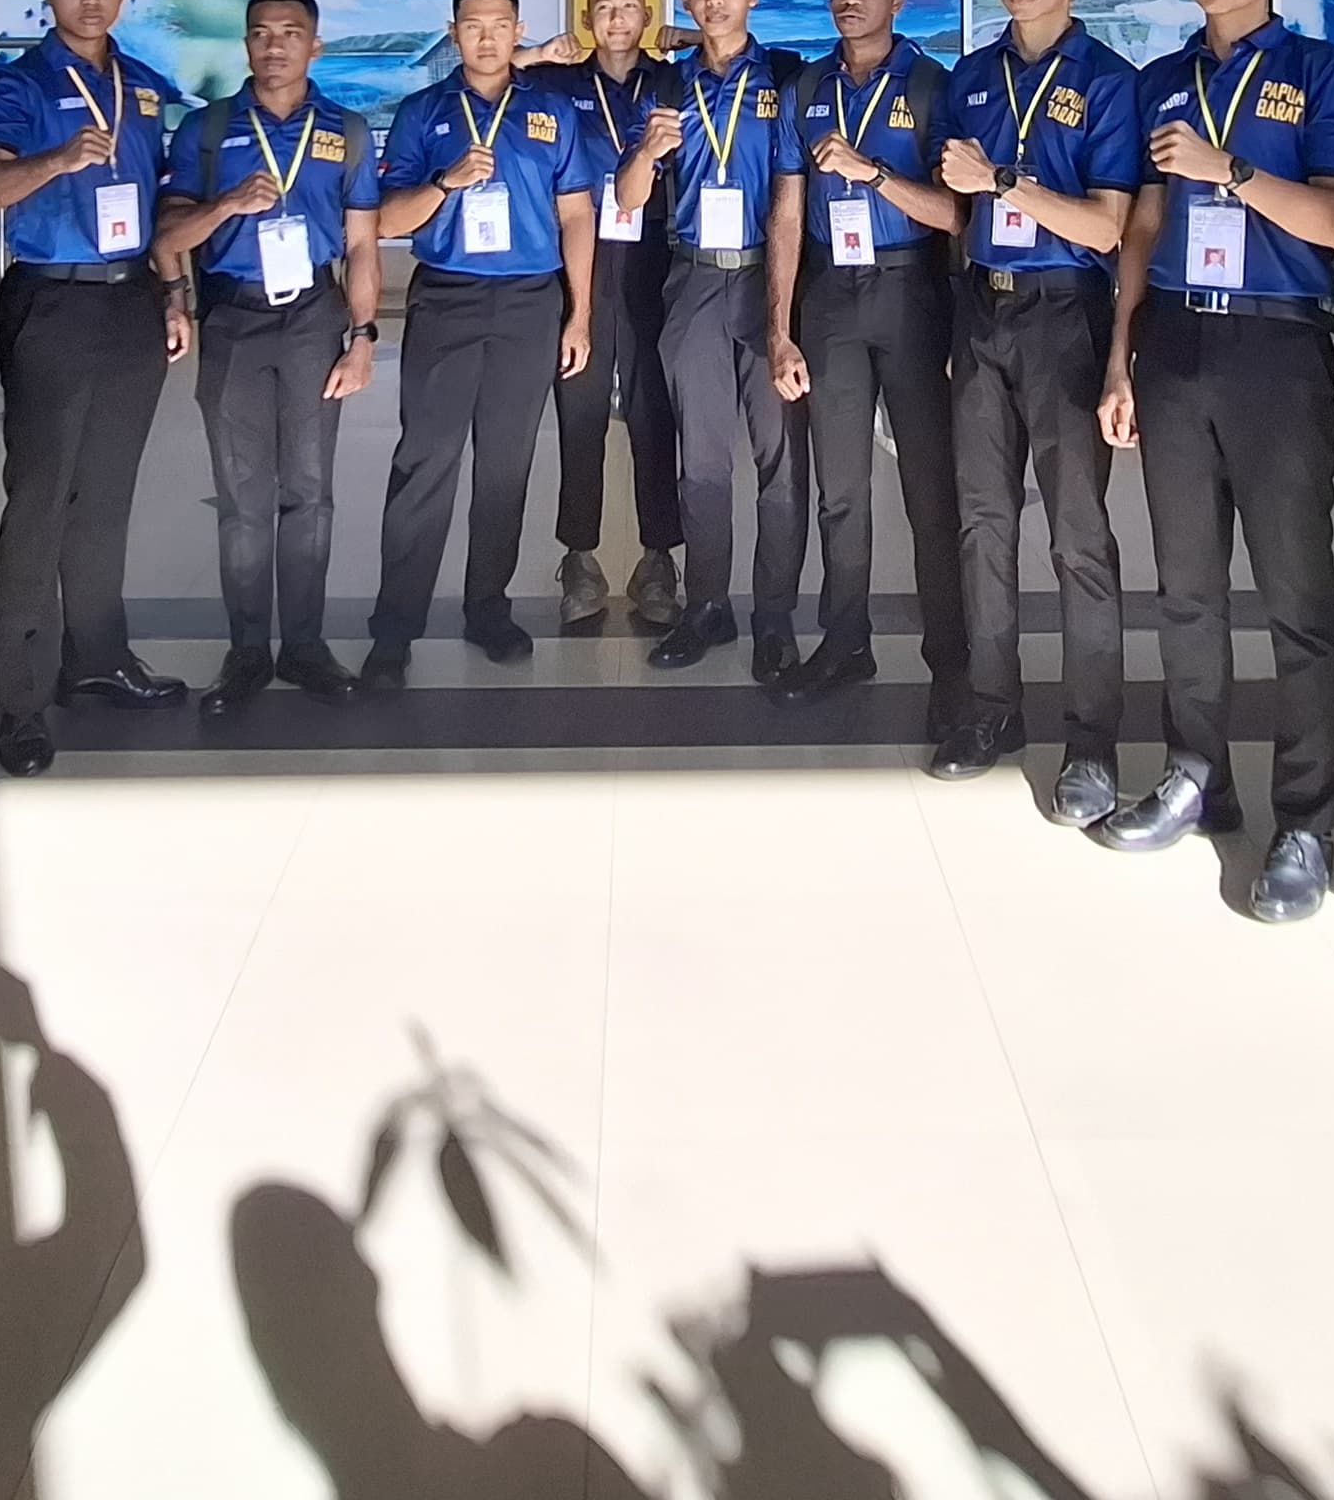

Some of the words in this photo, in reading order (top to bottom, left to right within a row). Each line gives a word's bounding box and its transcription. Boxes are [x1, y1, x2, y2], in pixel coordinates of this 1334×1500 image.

[1260, 80, 1305, 106] PAPUA
[756, 103, 778, 118] BAR
[1255, 98, 1304, 125] BARAT
